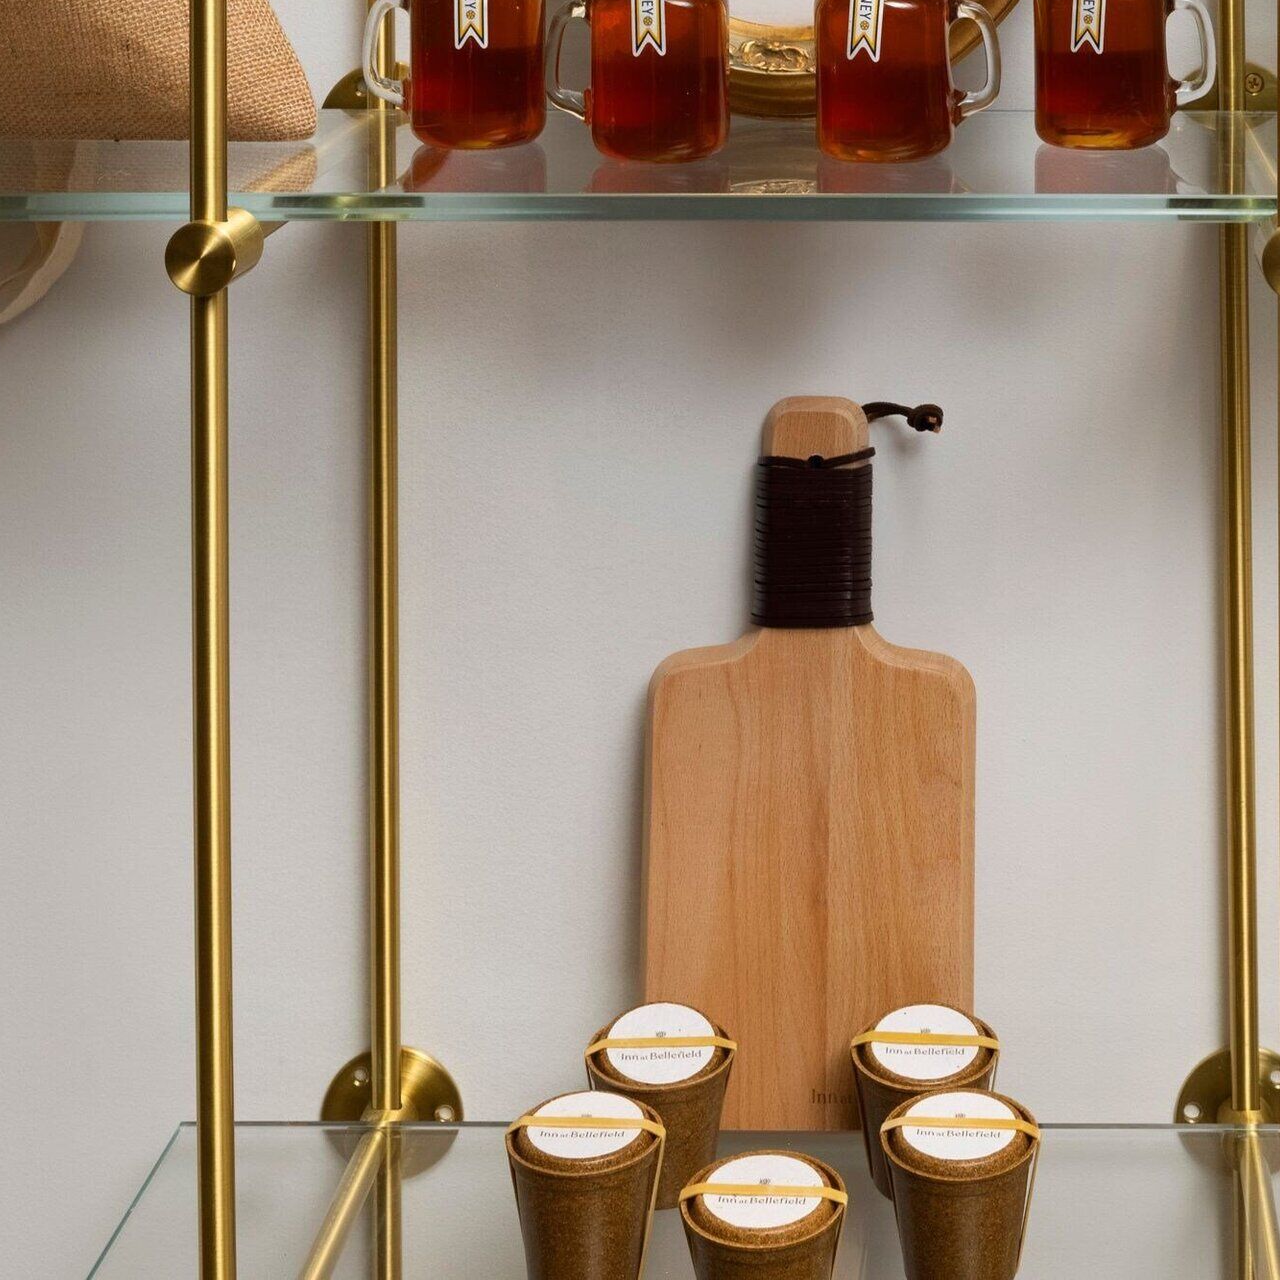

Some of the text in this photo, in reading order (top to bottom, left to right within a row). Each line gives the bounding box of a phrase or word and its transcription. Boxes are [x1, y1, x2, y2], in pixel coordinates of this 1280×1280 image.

[650, 1050, 701, 1060] Bellefield
[947, 1130, 1000, 1138] Bellefield
[750, 1197, 806, 1205] Bellefield
